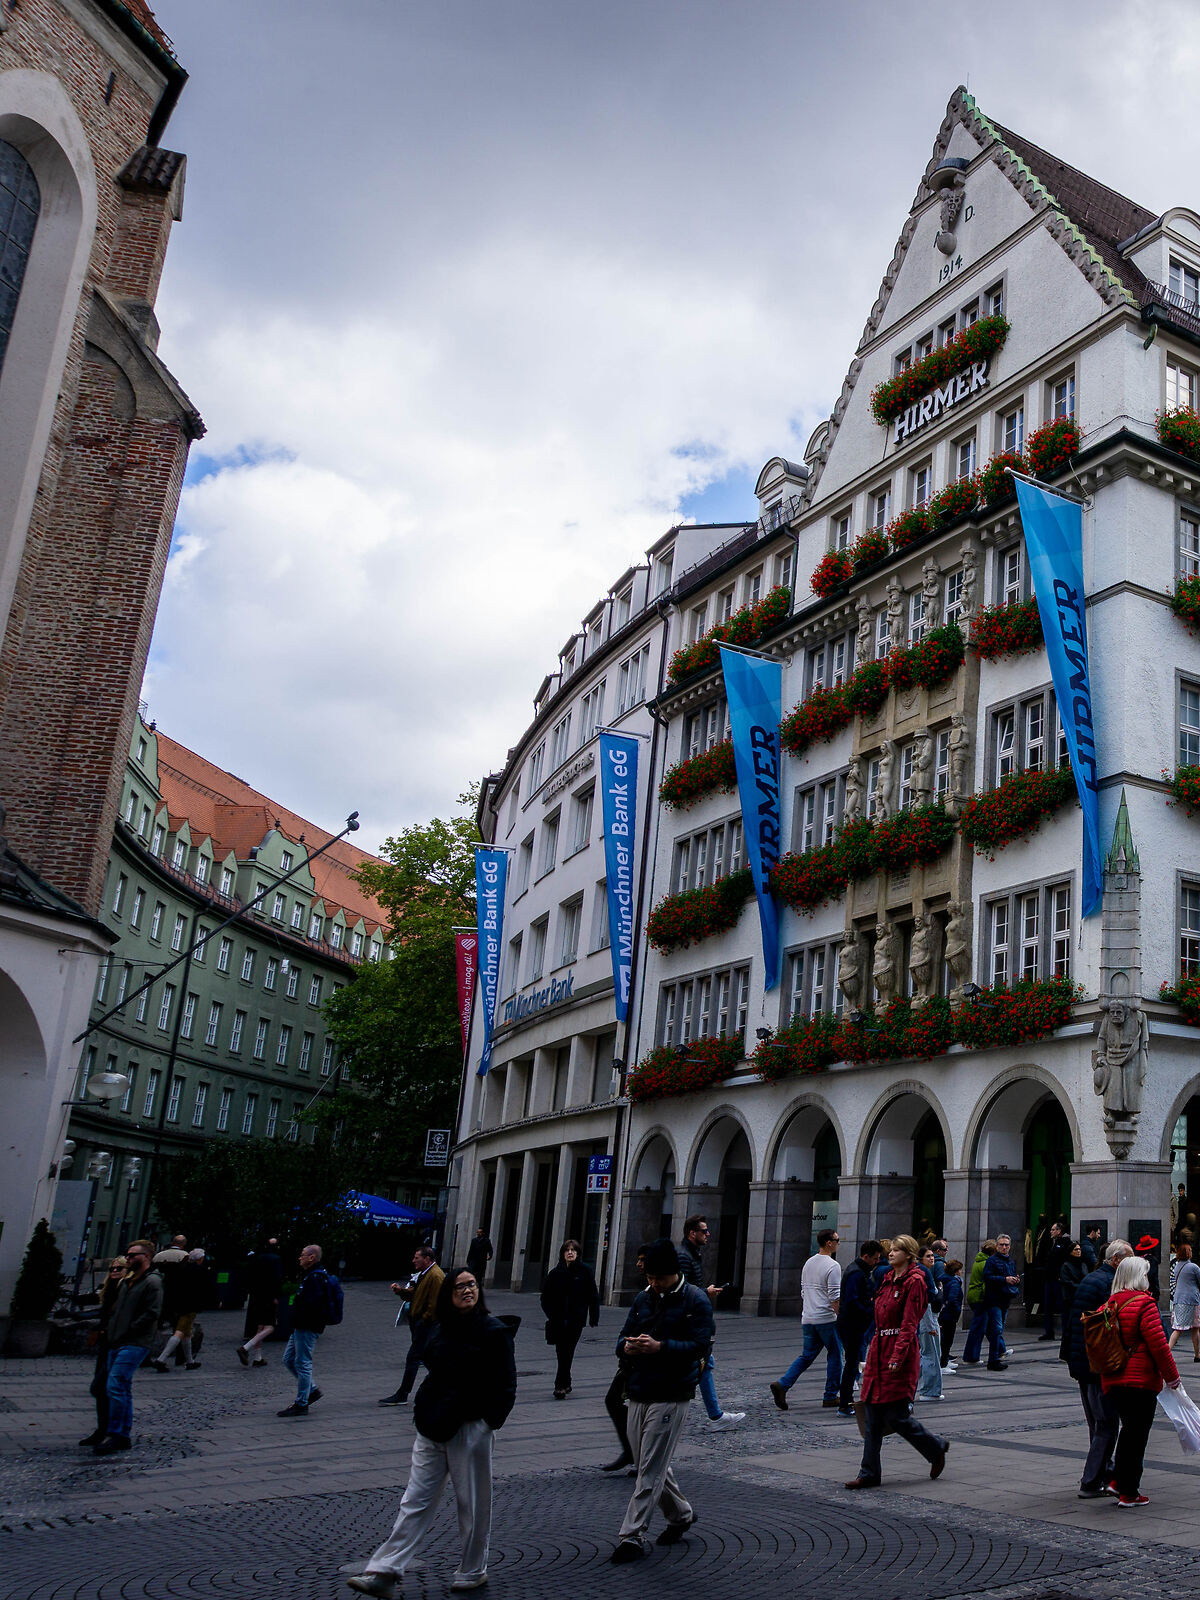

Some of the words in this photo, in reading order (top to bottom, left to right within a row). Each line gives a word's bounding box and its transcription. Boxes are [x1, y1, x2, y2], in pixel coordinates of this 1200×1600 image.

[894, 360, 988, 444] HIRMER
[609, 749, 628, 777] eG
[609, 782, 629, 837] Bank
[482, 861, 498, 883] eG
[483, 888, 498, 930] Bank
[613, 842, 633, 958] Münchner
